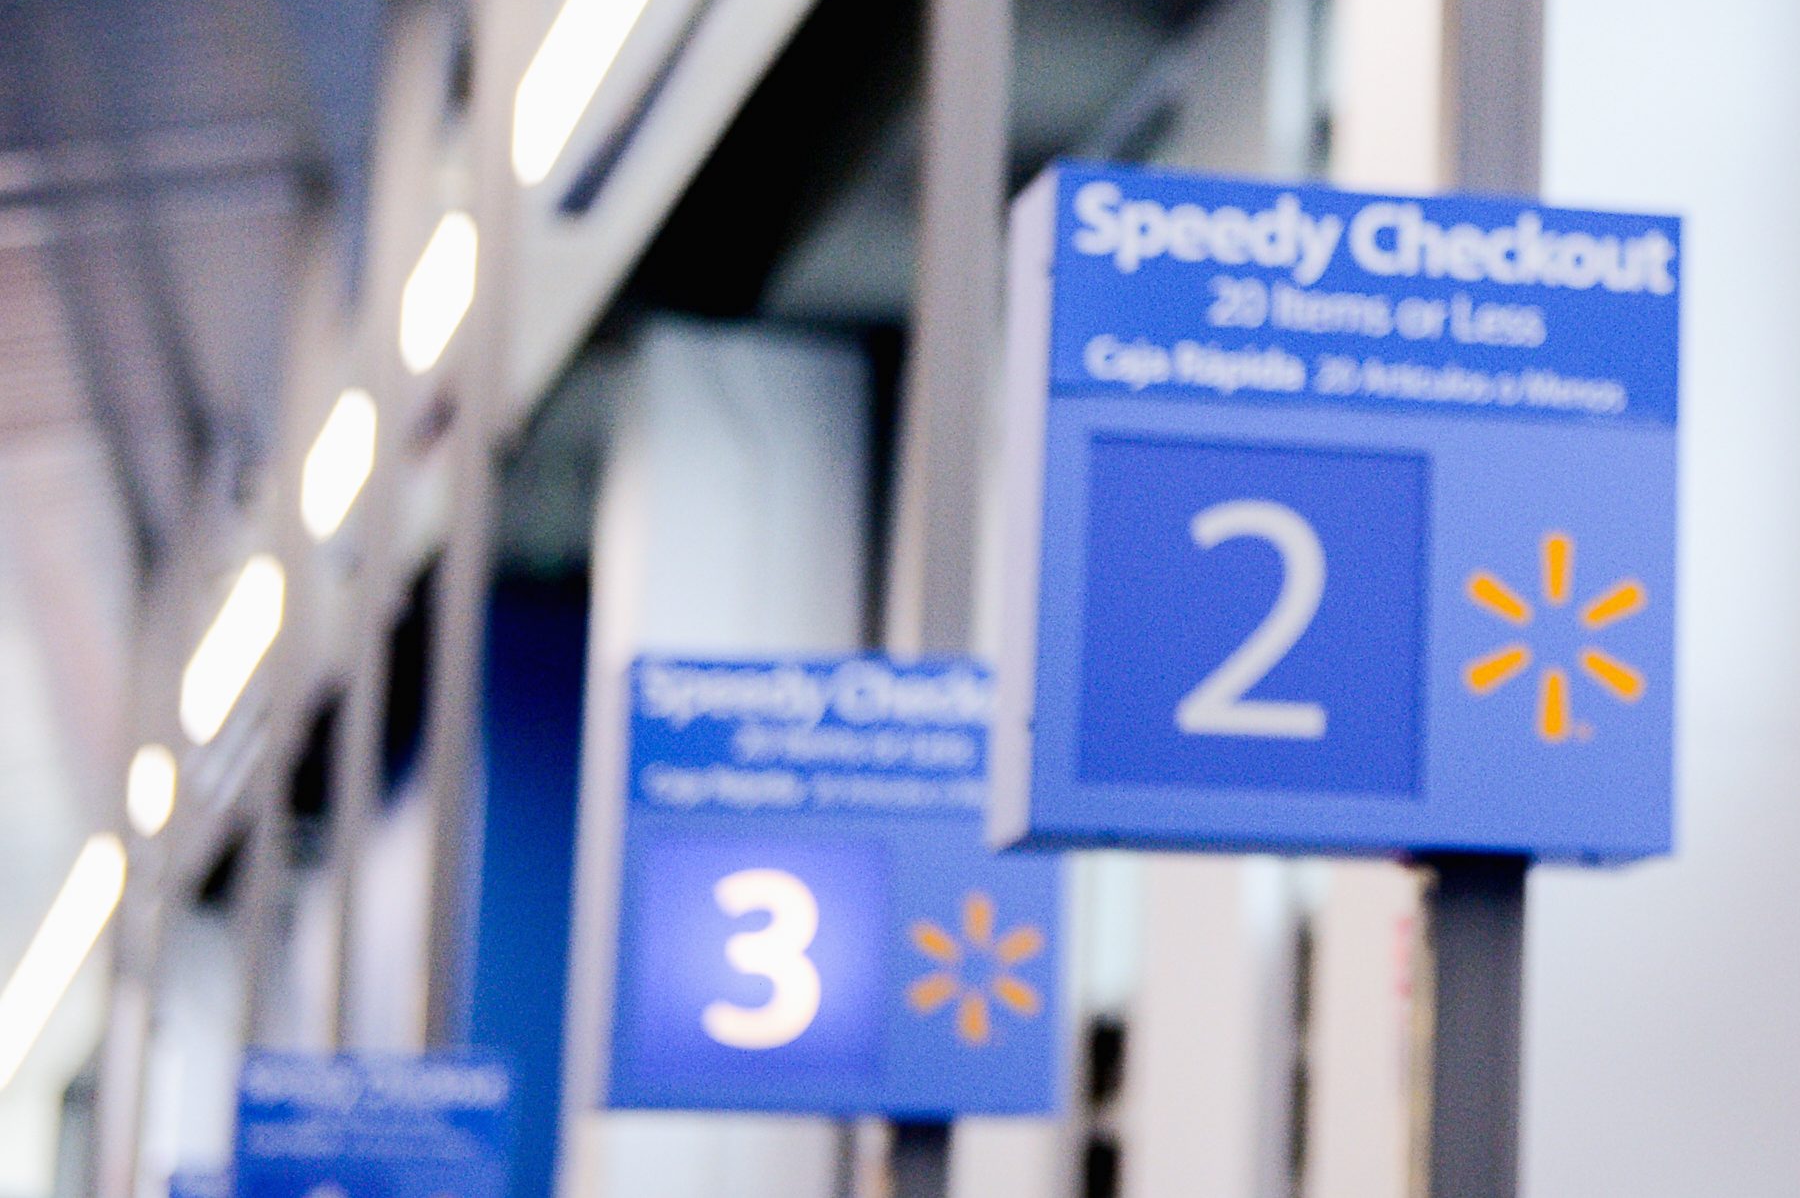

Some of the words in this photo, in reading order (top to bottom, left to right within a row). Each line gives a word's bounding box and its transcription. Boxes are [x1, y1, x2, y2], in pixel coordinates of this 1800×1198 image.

[1073, 180, 1344, 287] Speedy
[1348, 201, 1675, 296] Checkout
[1209, 275, 1267, 328] 20
[1450, 293, 1546, 348] Less
[1175, 499, 1326, 739] 2
[702, 867, 821, 1050] 3
